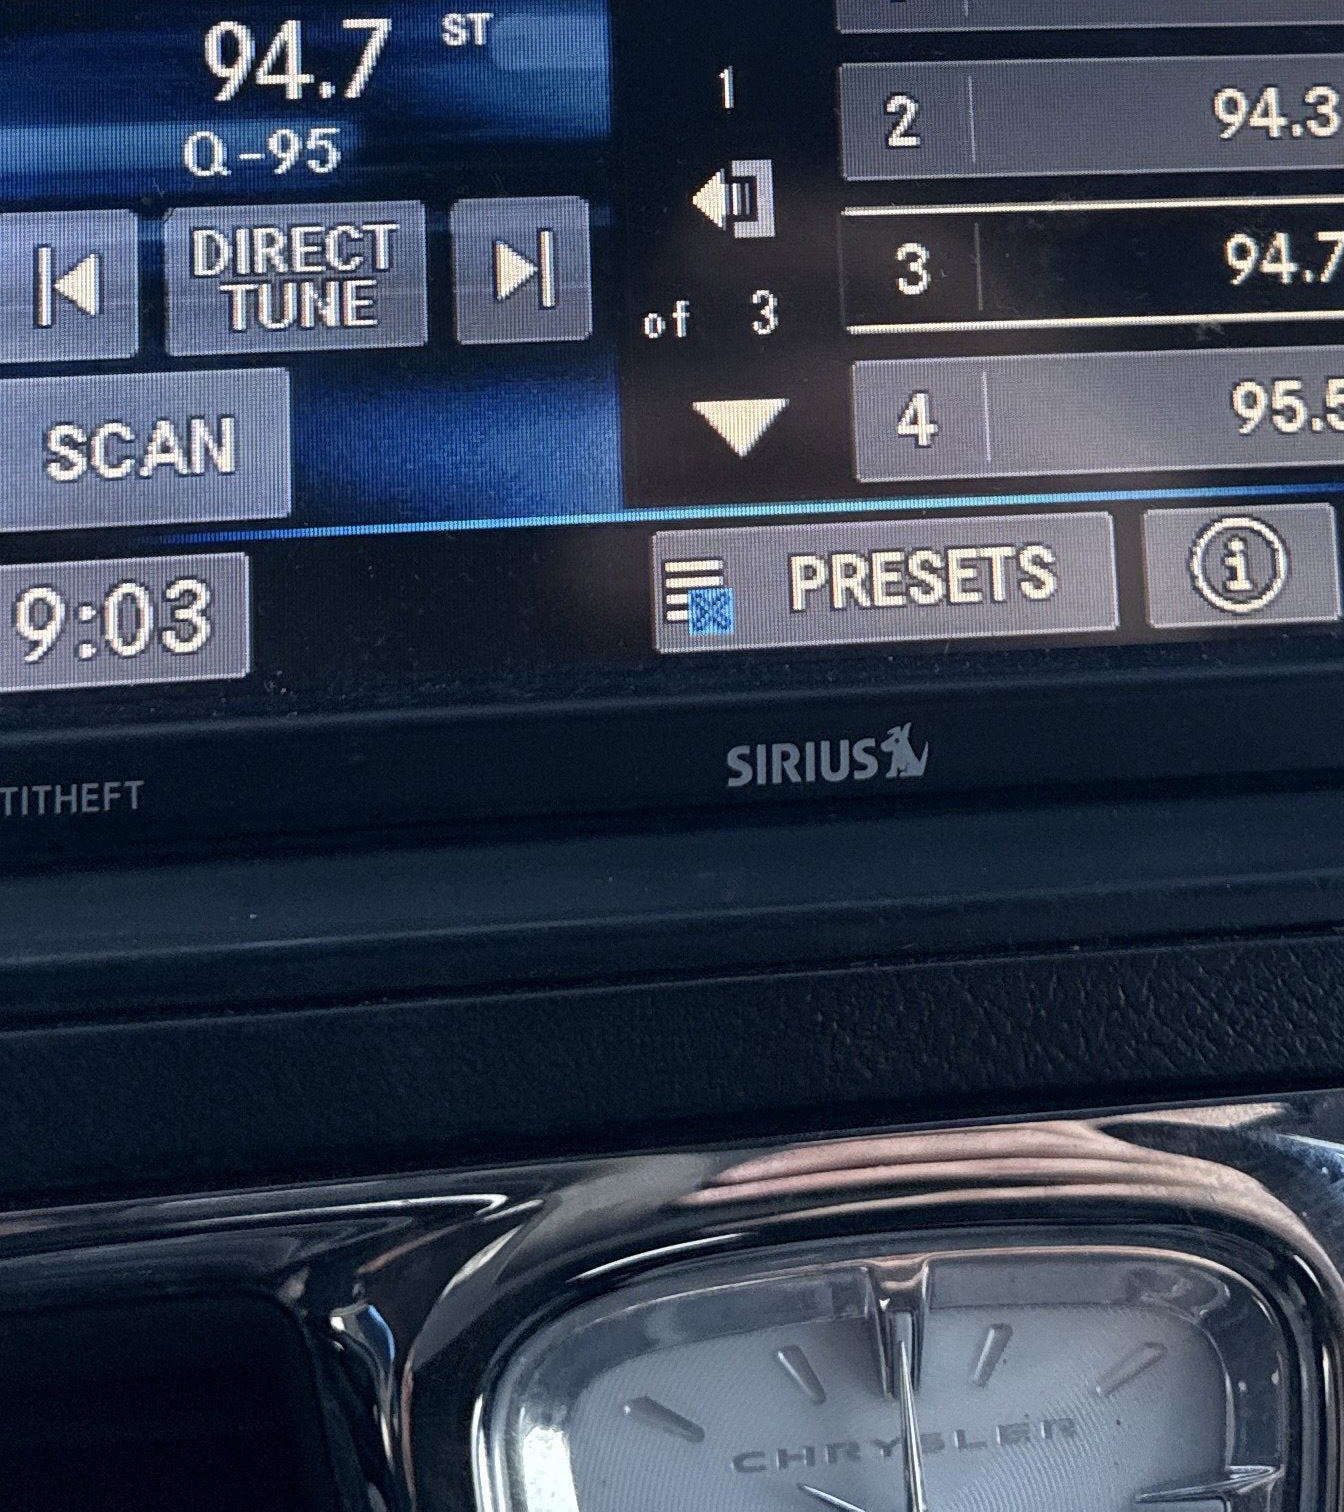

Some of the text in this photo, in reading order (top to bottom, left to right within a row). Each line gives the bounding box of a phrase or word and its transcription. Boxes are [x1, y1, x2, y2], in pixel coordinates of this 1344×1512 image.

[203, 13, 493, 101] 94.7 ST
[719, 65, 735, 109] 1
[885, 86, 1342, 147] 2 94.3
[192, 223, 400, 277] DIRECT
[896, 243, 931, 294] 3
[219, 279, 378, 330] TUNE
[643, 289, 778, 339] of 3
[897, 392, 937, 447] 4
[46, 416, 235, 481] SCAN
[789, 543, 1058, 611] PRESETS
[14, 578, 212, 663] 9:03
[727, 738, 878, 787] SIRIUS
[731, 1416, 1077, 1473] CHRYSLER
